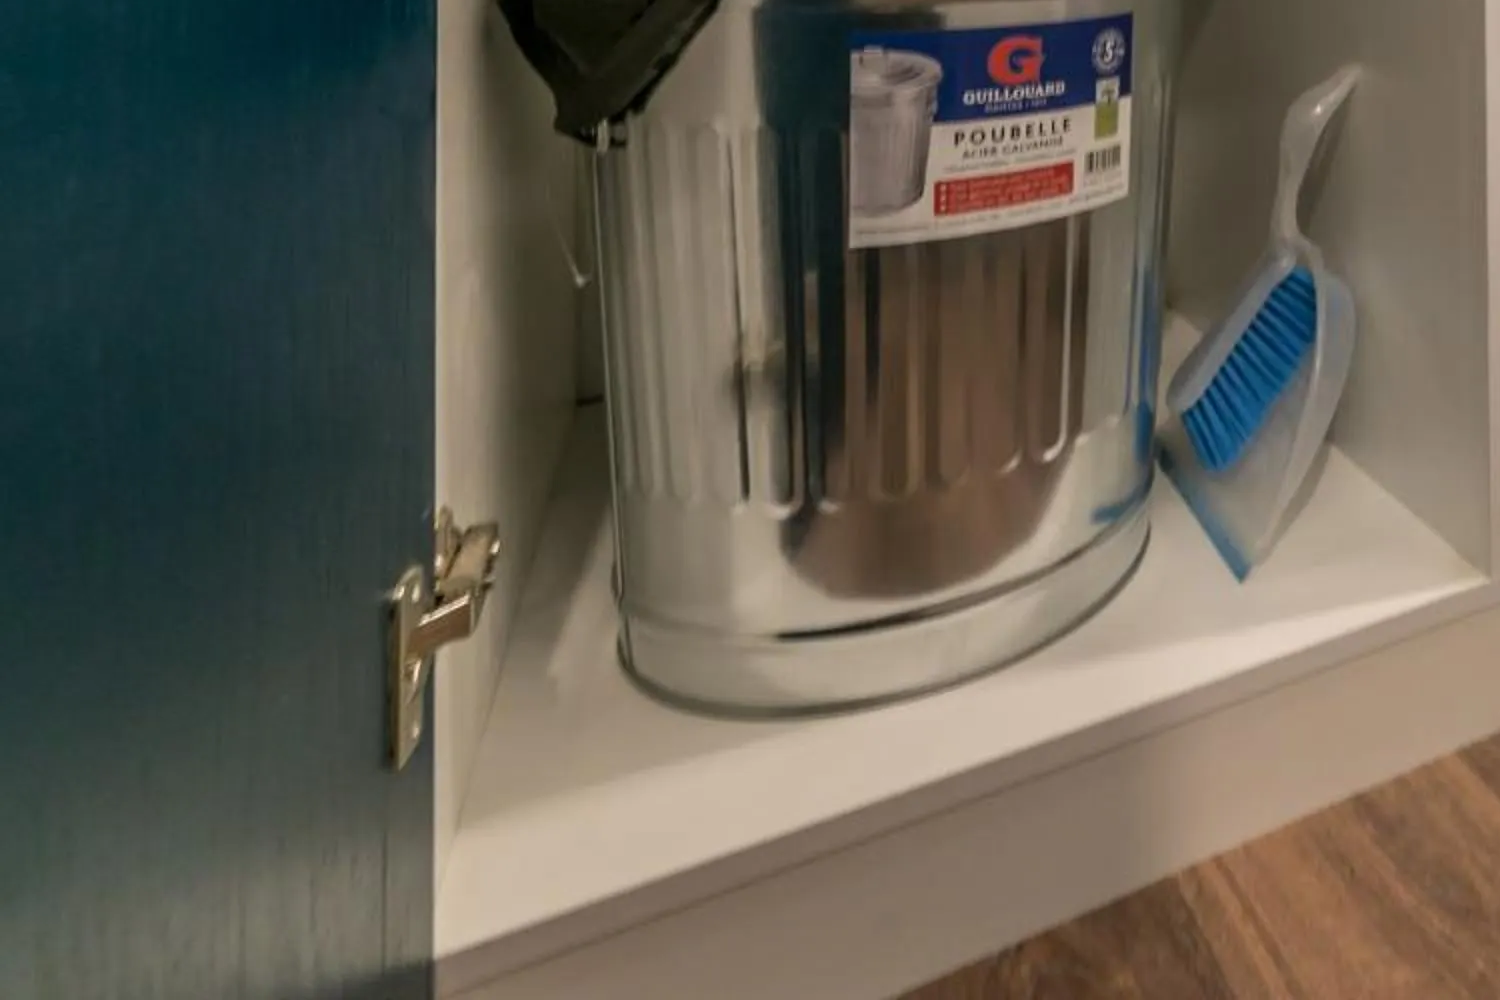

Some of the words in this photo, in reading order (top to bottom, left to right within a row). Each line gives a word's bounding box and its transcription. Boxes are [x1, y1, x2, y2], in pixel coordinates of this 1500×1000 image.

[987, 34, 1043, 84] G
[962, 80, 1066, 106] GUILLOUARD
[953, 117, 1072, 148] POUBELLE
